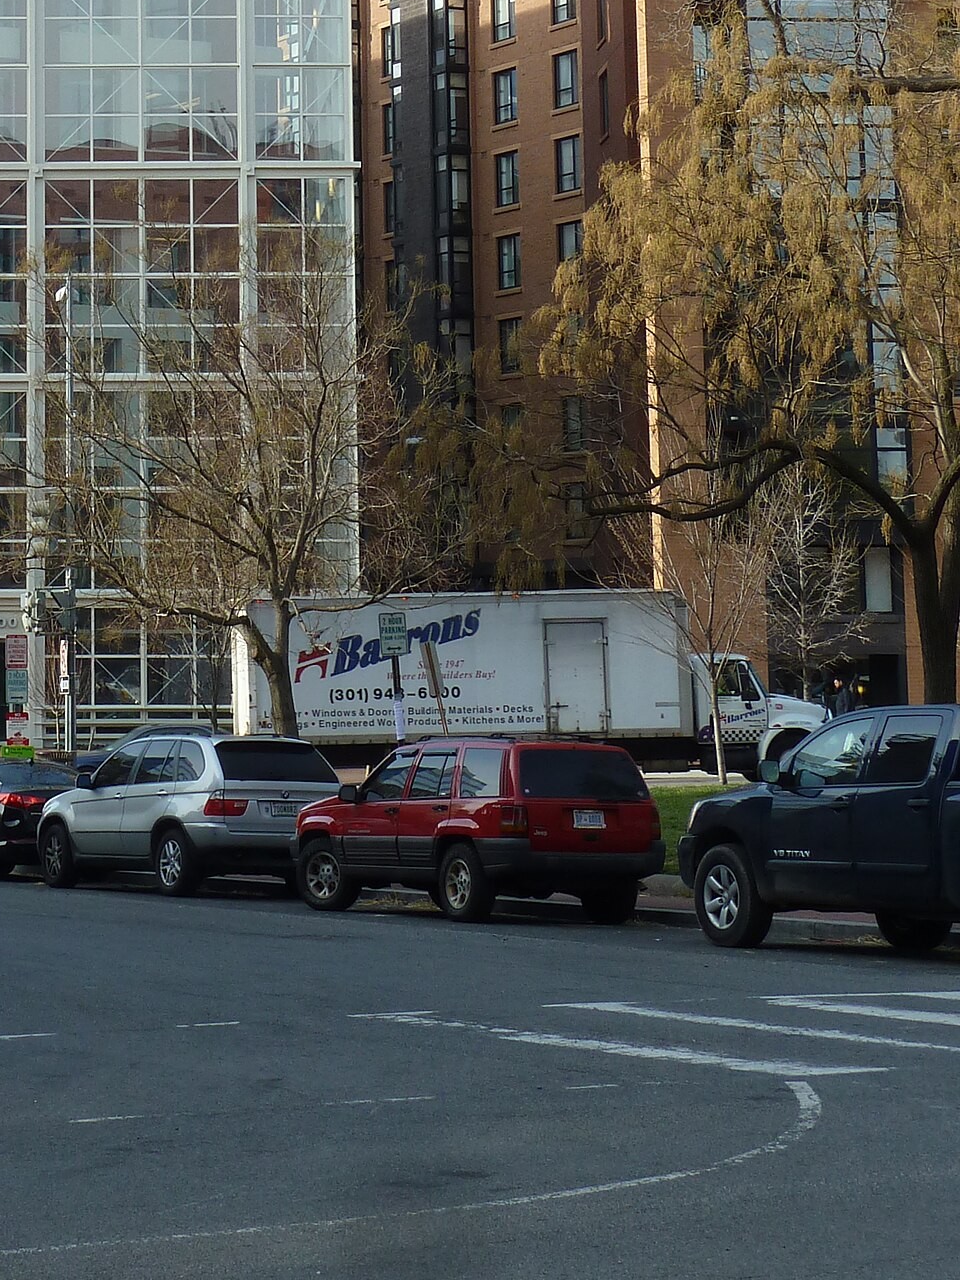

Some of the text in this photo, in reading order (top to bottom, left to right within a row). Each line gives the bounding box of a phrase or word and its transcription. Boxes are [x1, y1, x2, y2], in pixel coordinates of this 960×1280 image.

[382, 616, 403, 626] 2 HOUR
[381, 626, 405, 634] PARKING
[330, 608, 482, 678] Barons
[445, 659, 465, 669] 1947
[386, 671, 417, 681] Were
[440, 669, 473, 680] uilders
[475, 669, 496, 681] Buy!
[329, 686, 461, 704] (301) 94-600
[311, 708, 357, 718] Windows
[359, 708, 366, 717] &
[367, 707, 398, 717] Door
[448, 705, 493, 715] Materials
[502, 704, 534, 714] Decks
[727, 706, 767, 725] Barrons
[318, 719, 375, 730] Engineered
[407, 717, 452, 727] Producs
[461, 716, 506, 725] Kitchens
[507, 715, 515, 724] &
[516, 714, 544, 724] More!
